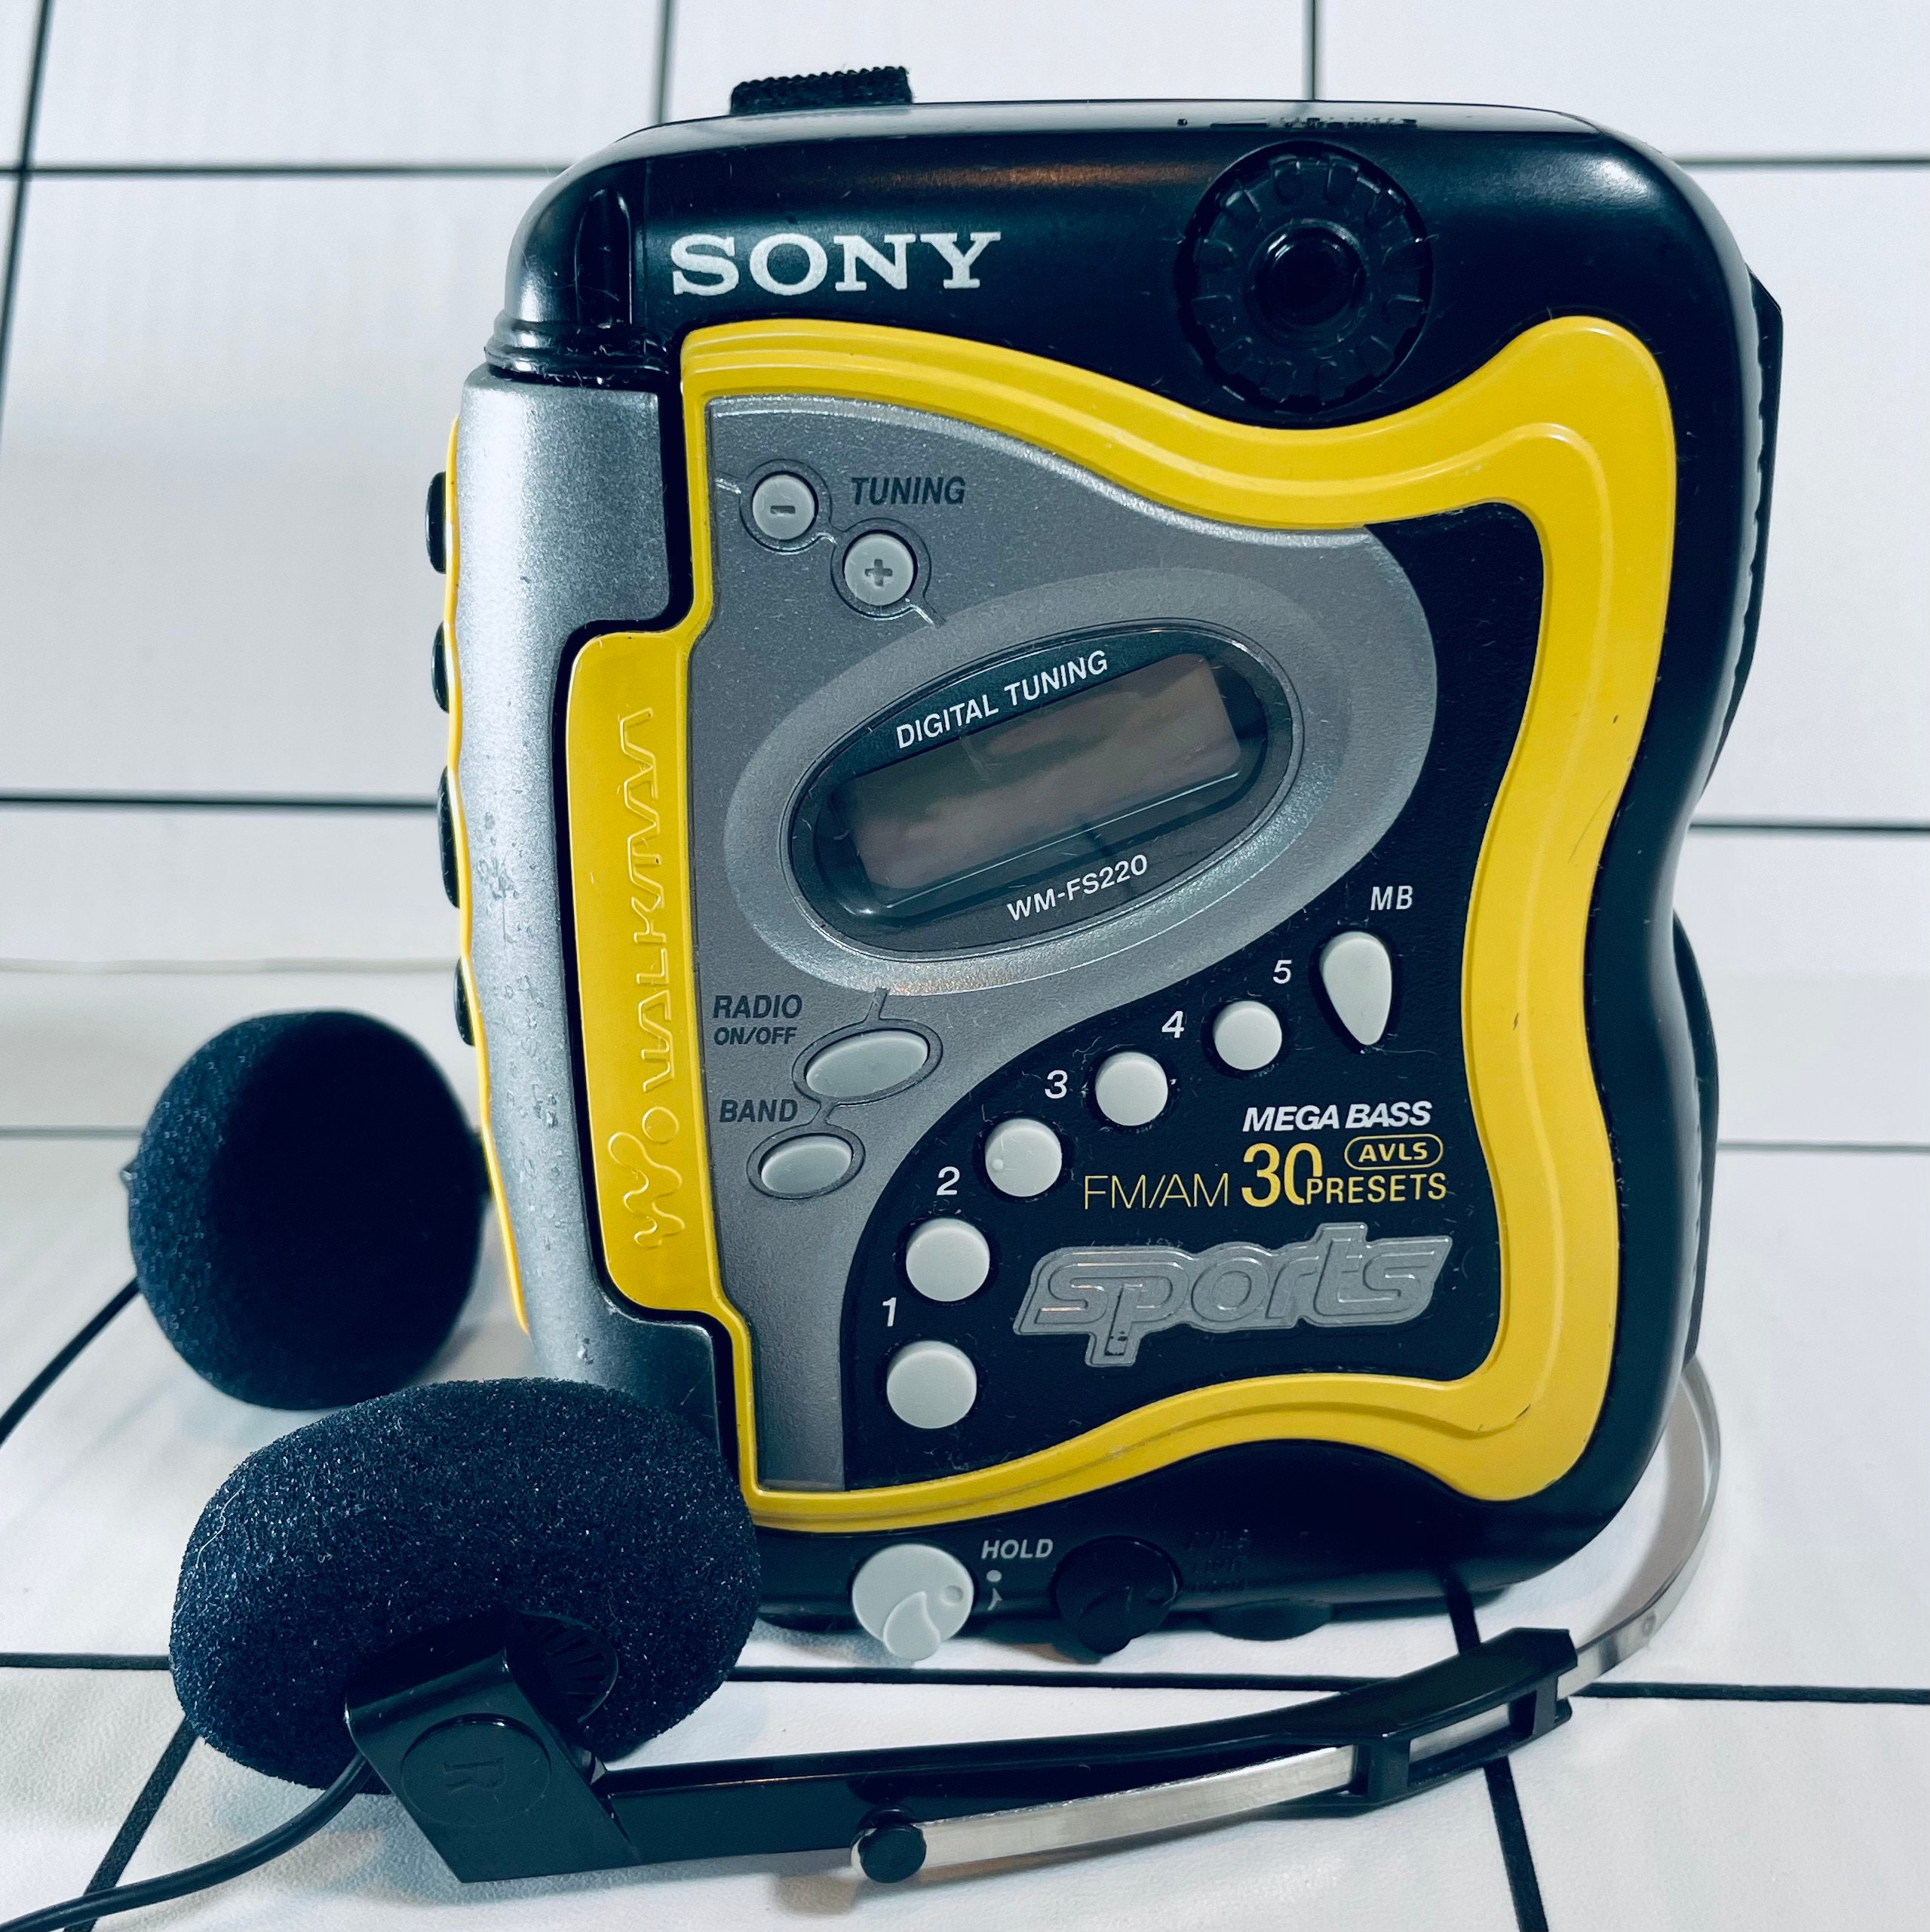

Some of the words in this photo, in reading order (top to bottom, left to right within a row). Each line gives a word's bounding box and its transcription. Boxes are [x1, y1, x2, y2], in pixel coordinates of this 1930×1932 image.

[670, 232, 1002, 296] SONY
[851, 477, 966, 505] TUNING
[896, 694, 999, 748] DIGITAL
[1004, 650, 1108, 706] TUNING
[1006, 854, 1148, 921] WM-FS220
[1370, 886, 1413, 911] MB
[1273, 960, 1293, 983] 5
[712, 994, 803, 1019] RADIO
[713, 1027, 798, 1046] ON/OFF
[1161, 1012, 1185, 1038] 4
[1045, 1070, 1067, 1099] 3
[719, 1099, 799, 1123] BAND
[1243, 1105, 1339, 1132] MEGA
[1345, 1101, 1432, 1129] BASS
[1358, 1143, 1428, 1163] AVLS
[936, 1167, 959, 1195] 2
[1085, 1173, 1229, 1209] FM/AM
[1241, 1143, 1322, 1207] 30
[1306, 1172, 1447, 1205] PRESETS
[1022, 1228, 1444, 1362] sports
[882, 1298, 897, 1326] 1
[981, 1538, 1054, 1559] HOLD
